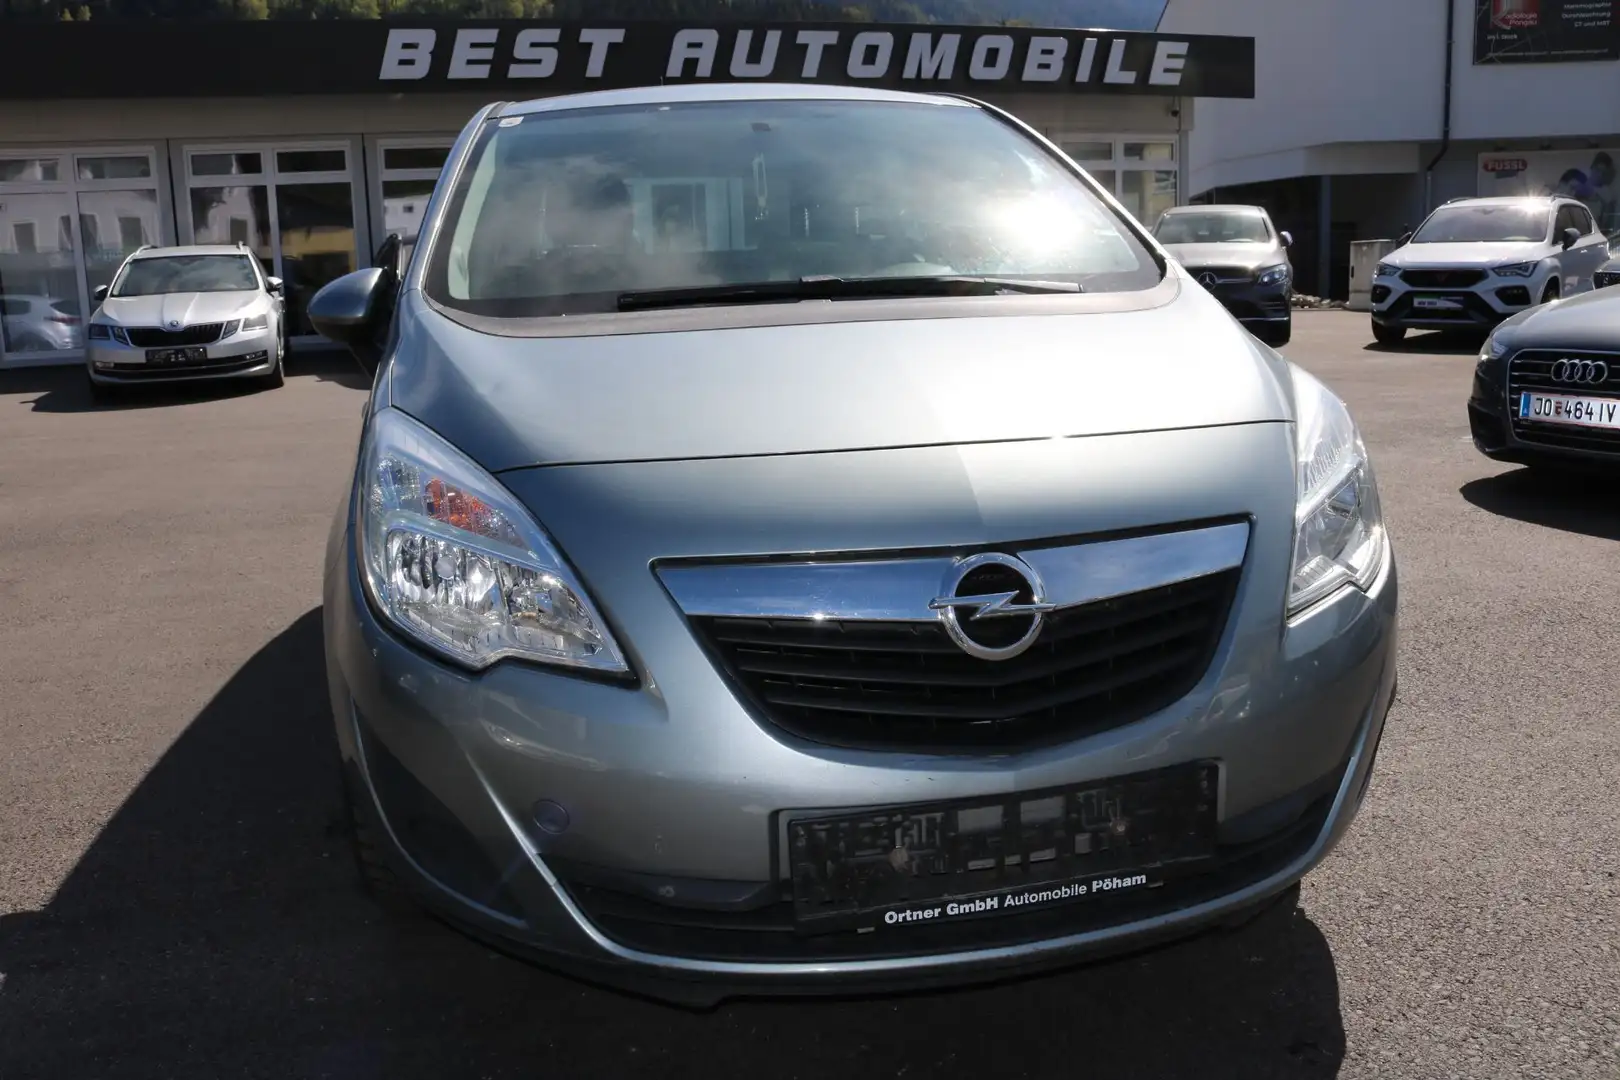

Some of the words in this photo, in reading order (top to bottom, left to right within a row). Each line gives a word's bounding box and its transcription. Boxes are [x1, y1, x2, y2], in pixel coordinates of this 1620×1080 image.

[378, 28, 626, 80] BEST
[666, 29, 1190, 86] AUTOMOBILE
[1487, 160, 1525, 171] FUSSL
[884, 906, 942, 924] Ortner
[946, 897, 999, 916] GmbH
[1003, 883, 1088, 908] Automobile
[1091, 874, 1147, 893] Pöham
